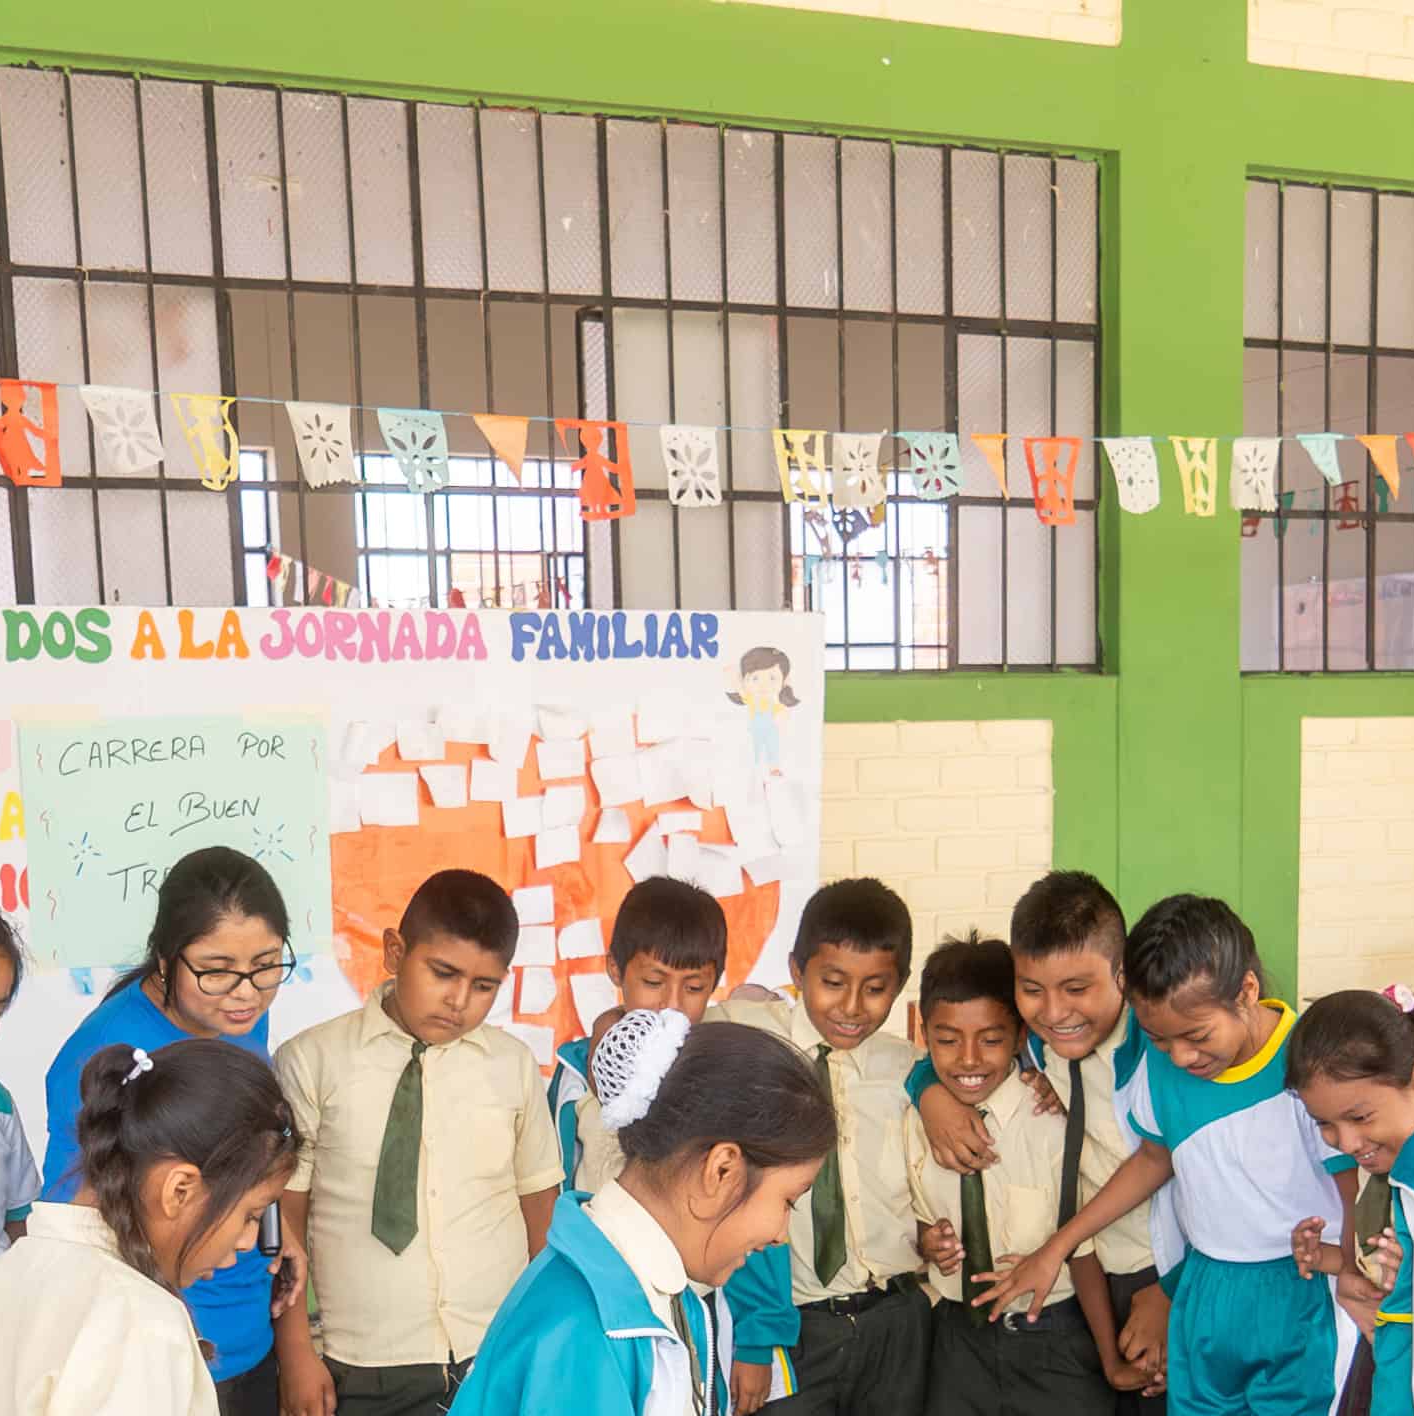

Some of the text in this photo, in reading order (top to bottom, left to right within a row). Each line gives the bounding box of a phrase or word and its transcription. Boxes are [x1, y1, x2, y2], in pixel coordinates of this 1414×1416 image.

[130, 610, 166, 660] A
[178, 609, 250, 660] LA
[260, 609, 488, 663] JORNADA
[509, 611, 719, 663] FAMILIAR
[58, 732, 287, 776] CARRERA POR
[124, 791, 261, 837] EL BUEN
[107, 861, 171, 903] TR
